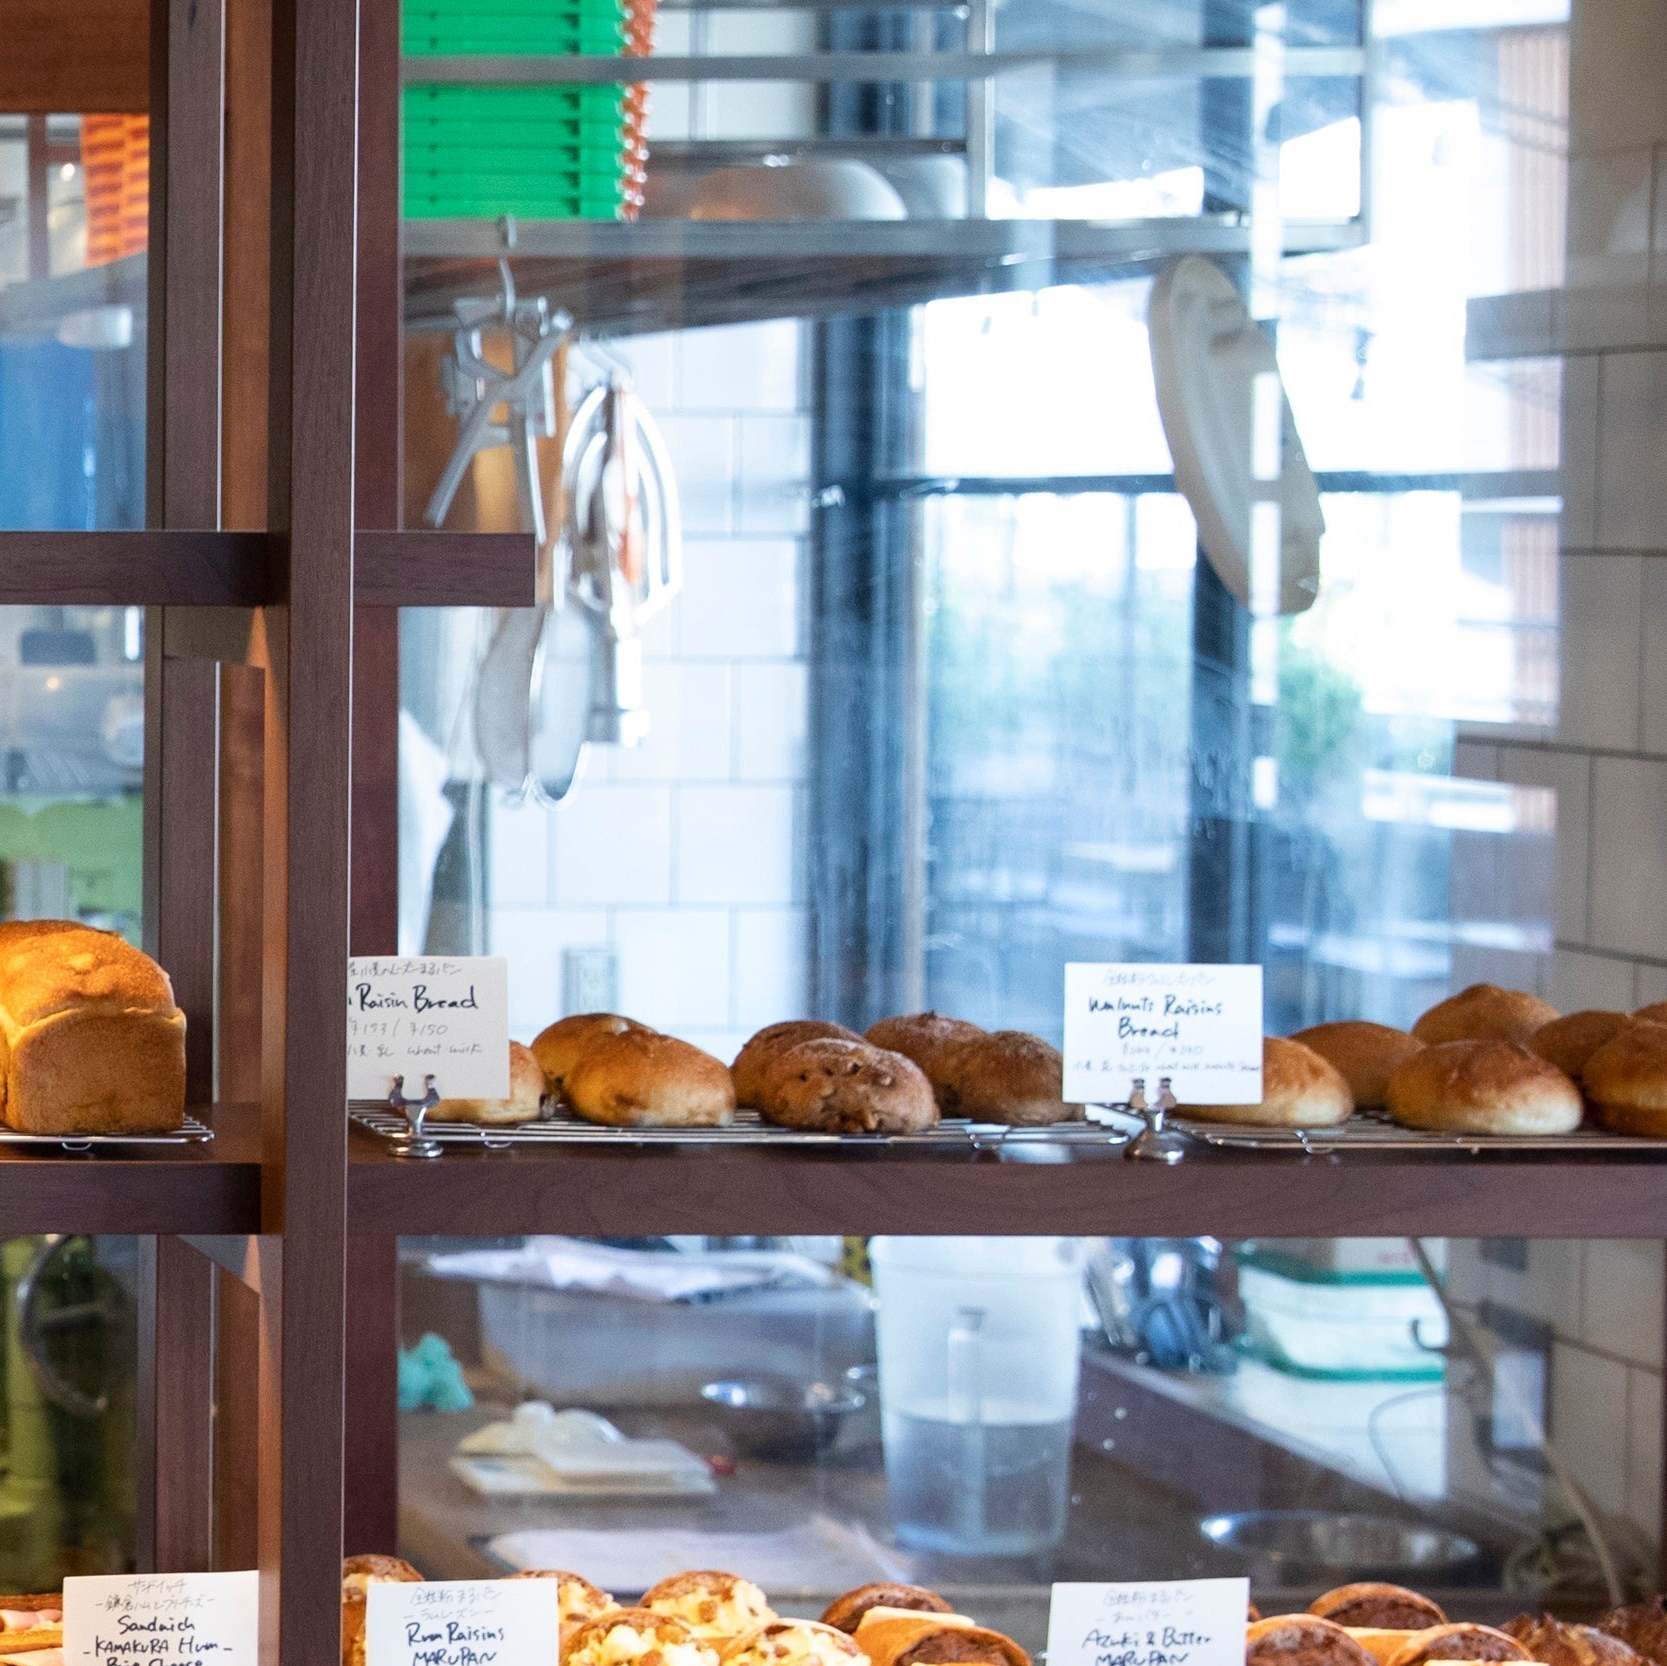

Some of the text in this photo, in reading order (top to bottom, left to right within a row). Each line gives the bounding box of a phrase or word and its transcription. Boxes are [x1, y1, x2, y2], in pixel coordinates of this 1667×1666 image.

[356, 983, 478, 1014] Raisin Bread
[1089, 994, 1222, 1016] Walnuts Raisins
[1119, 1016, 1179, 1039] Bread
[405, 1622, 504, 1647] Rum Raisins
[1082, 1627, 1211, 1648] Azuki & Butter
